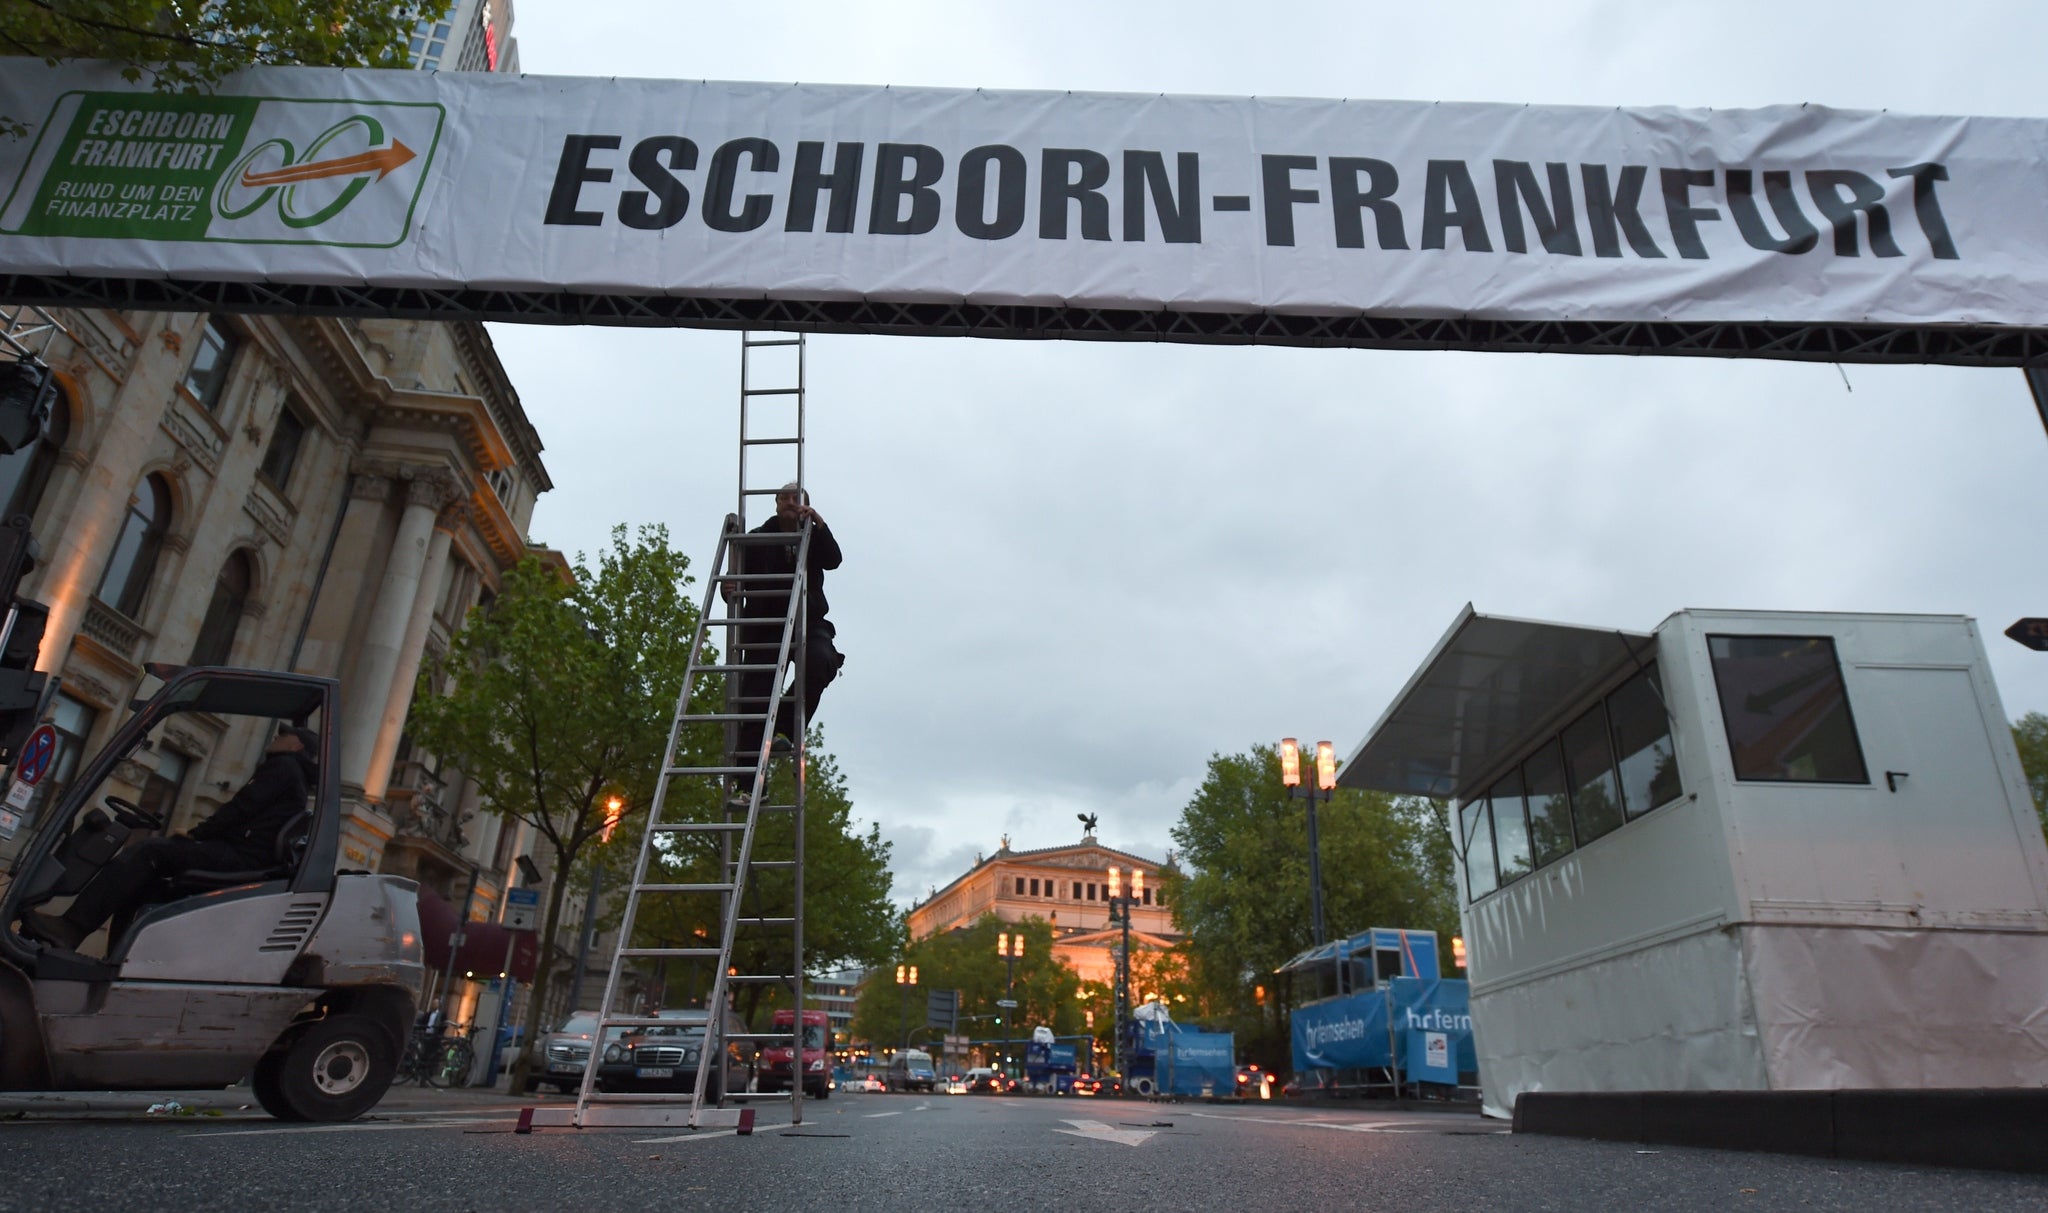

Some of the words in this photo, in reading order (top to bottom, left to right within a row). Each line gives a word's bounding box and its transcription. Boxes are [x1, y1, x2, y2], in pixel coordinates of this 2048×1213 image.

[86, 109, 235, 140] ESCHBORN
[71, 139, 223, 170] FRANKFURT
[54, 181, 114, 198] RUND
[120, 184, 155, 200] UM
[160, 186, 205, 202] DEN
[543, 133, 1961, 261] ESCHBORN-FRANKFURT
[46, 200, 196, 221] FINANZPLATZ
